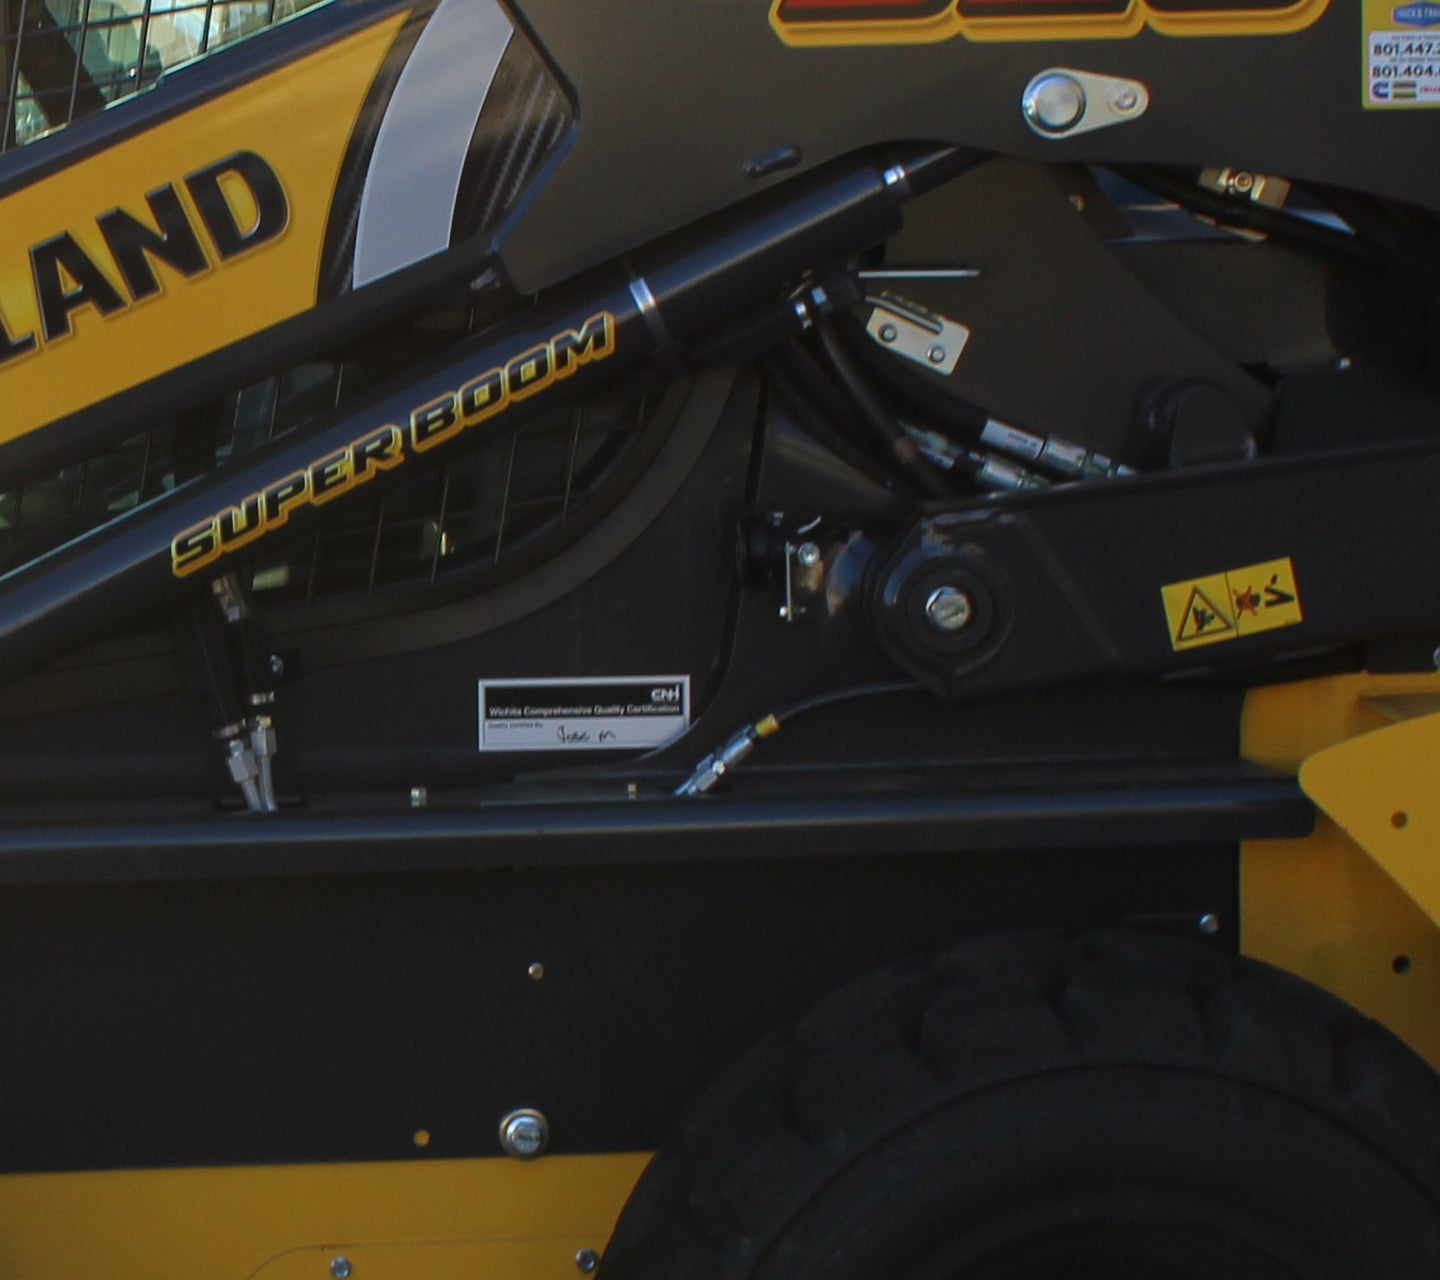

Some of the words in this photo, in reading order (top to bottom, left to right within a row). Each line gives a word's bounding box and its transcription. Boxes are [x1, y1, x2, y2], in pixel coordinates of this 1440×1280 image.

[171, 424, 405, 578] SUPER
[411, 310, 616, 452] BOOM
[523, 705, 593, 718] Comprehensive
[594, 704, 624, 716] Quality
[626, 703, 680, 714] Certification
